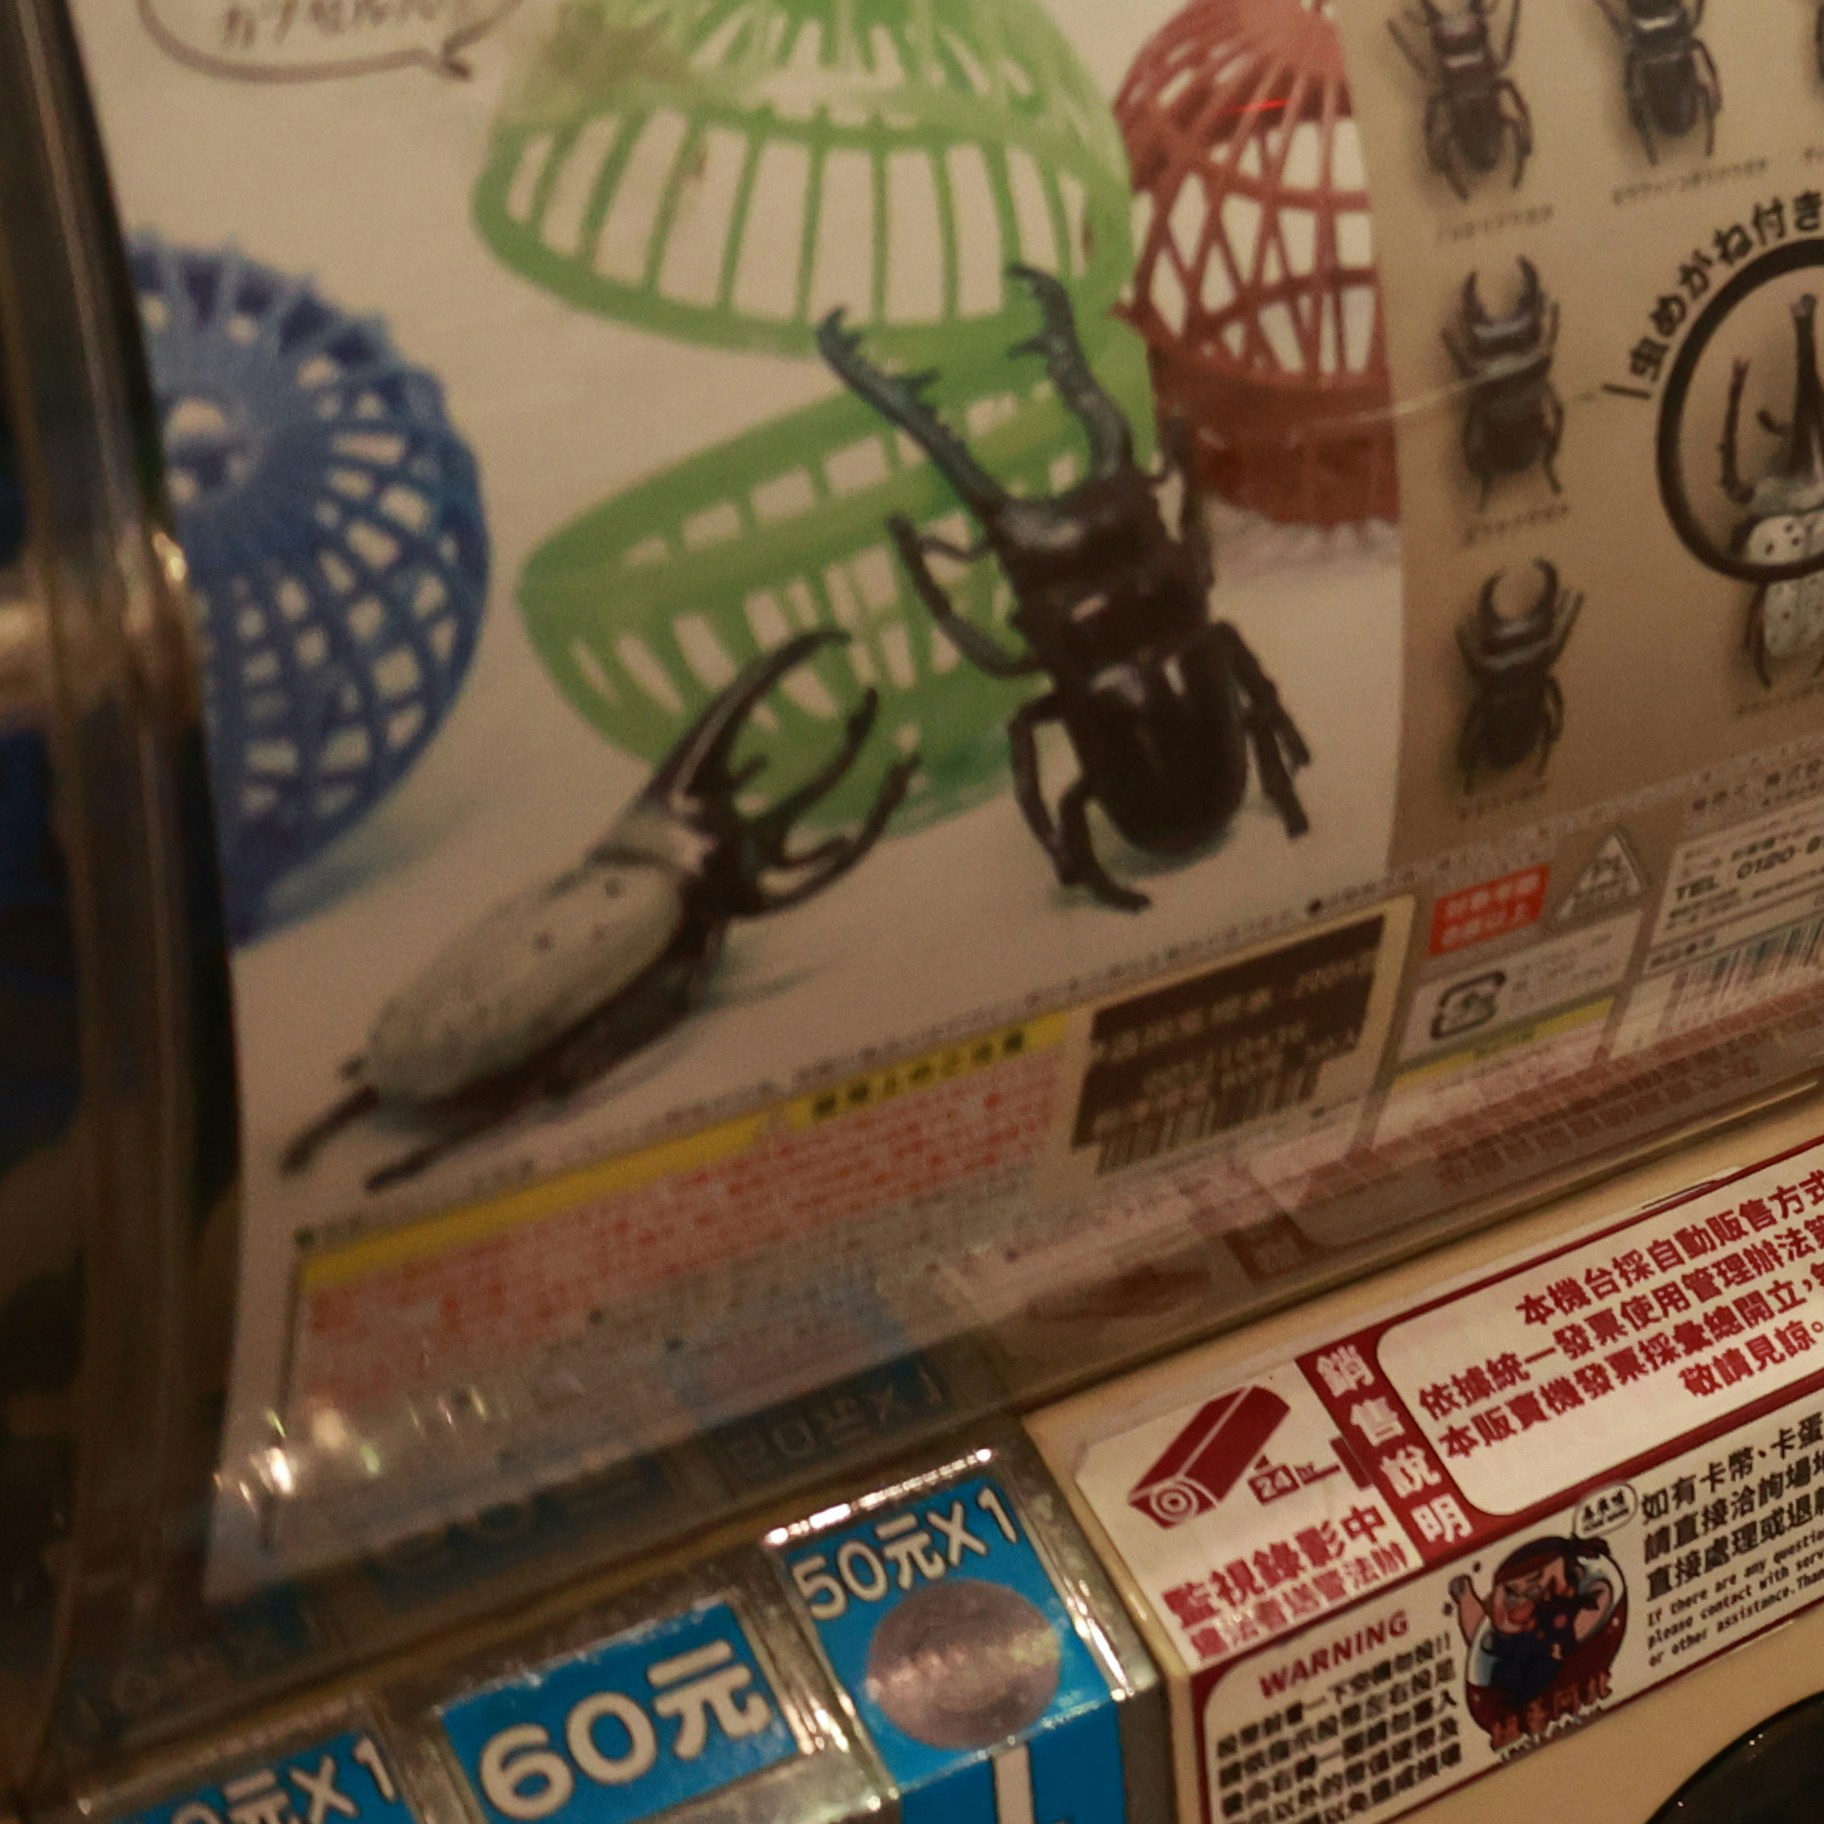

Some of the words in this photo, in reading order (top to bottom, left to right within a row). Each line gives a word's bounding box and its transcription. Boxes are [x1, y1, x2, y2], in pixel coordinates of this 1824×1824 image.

[1315, 1344, 1473, 1545] 銷售說明
[476, 1637, 771, 1819] 60元
[1259, 1608, 1411, 1700] WARNING
